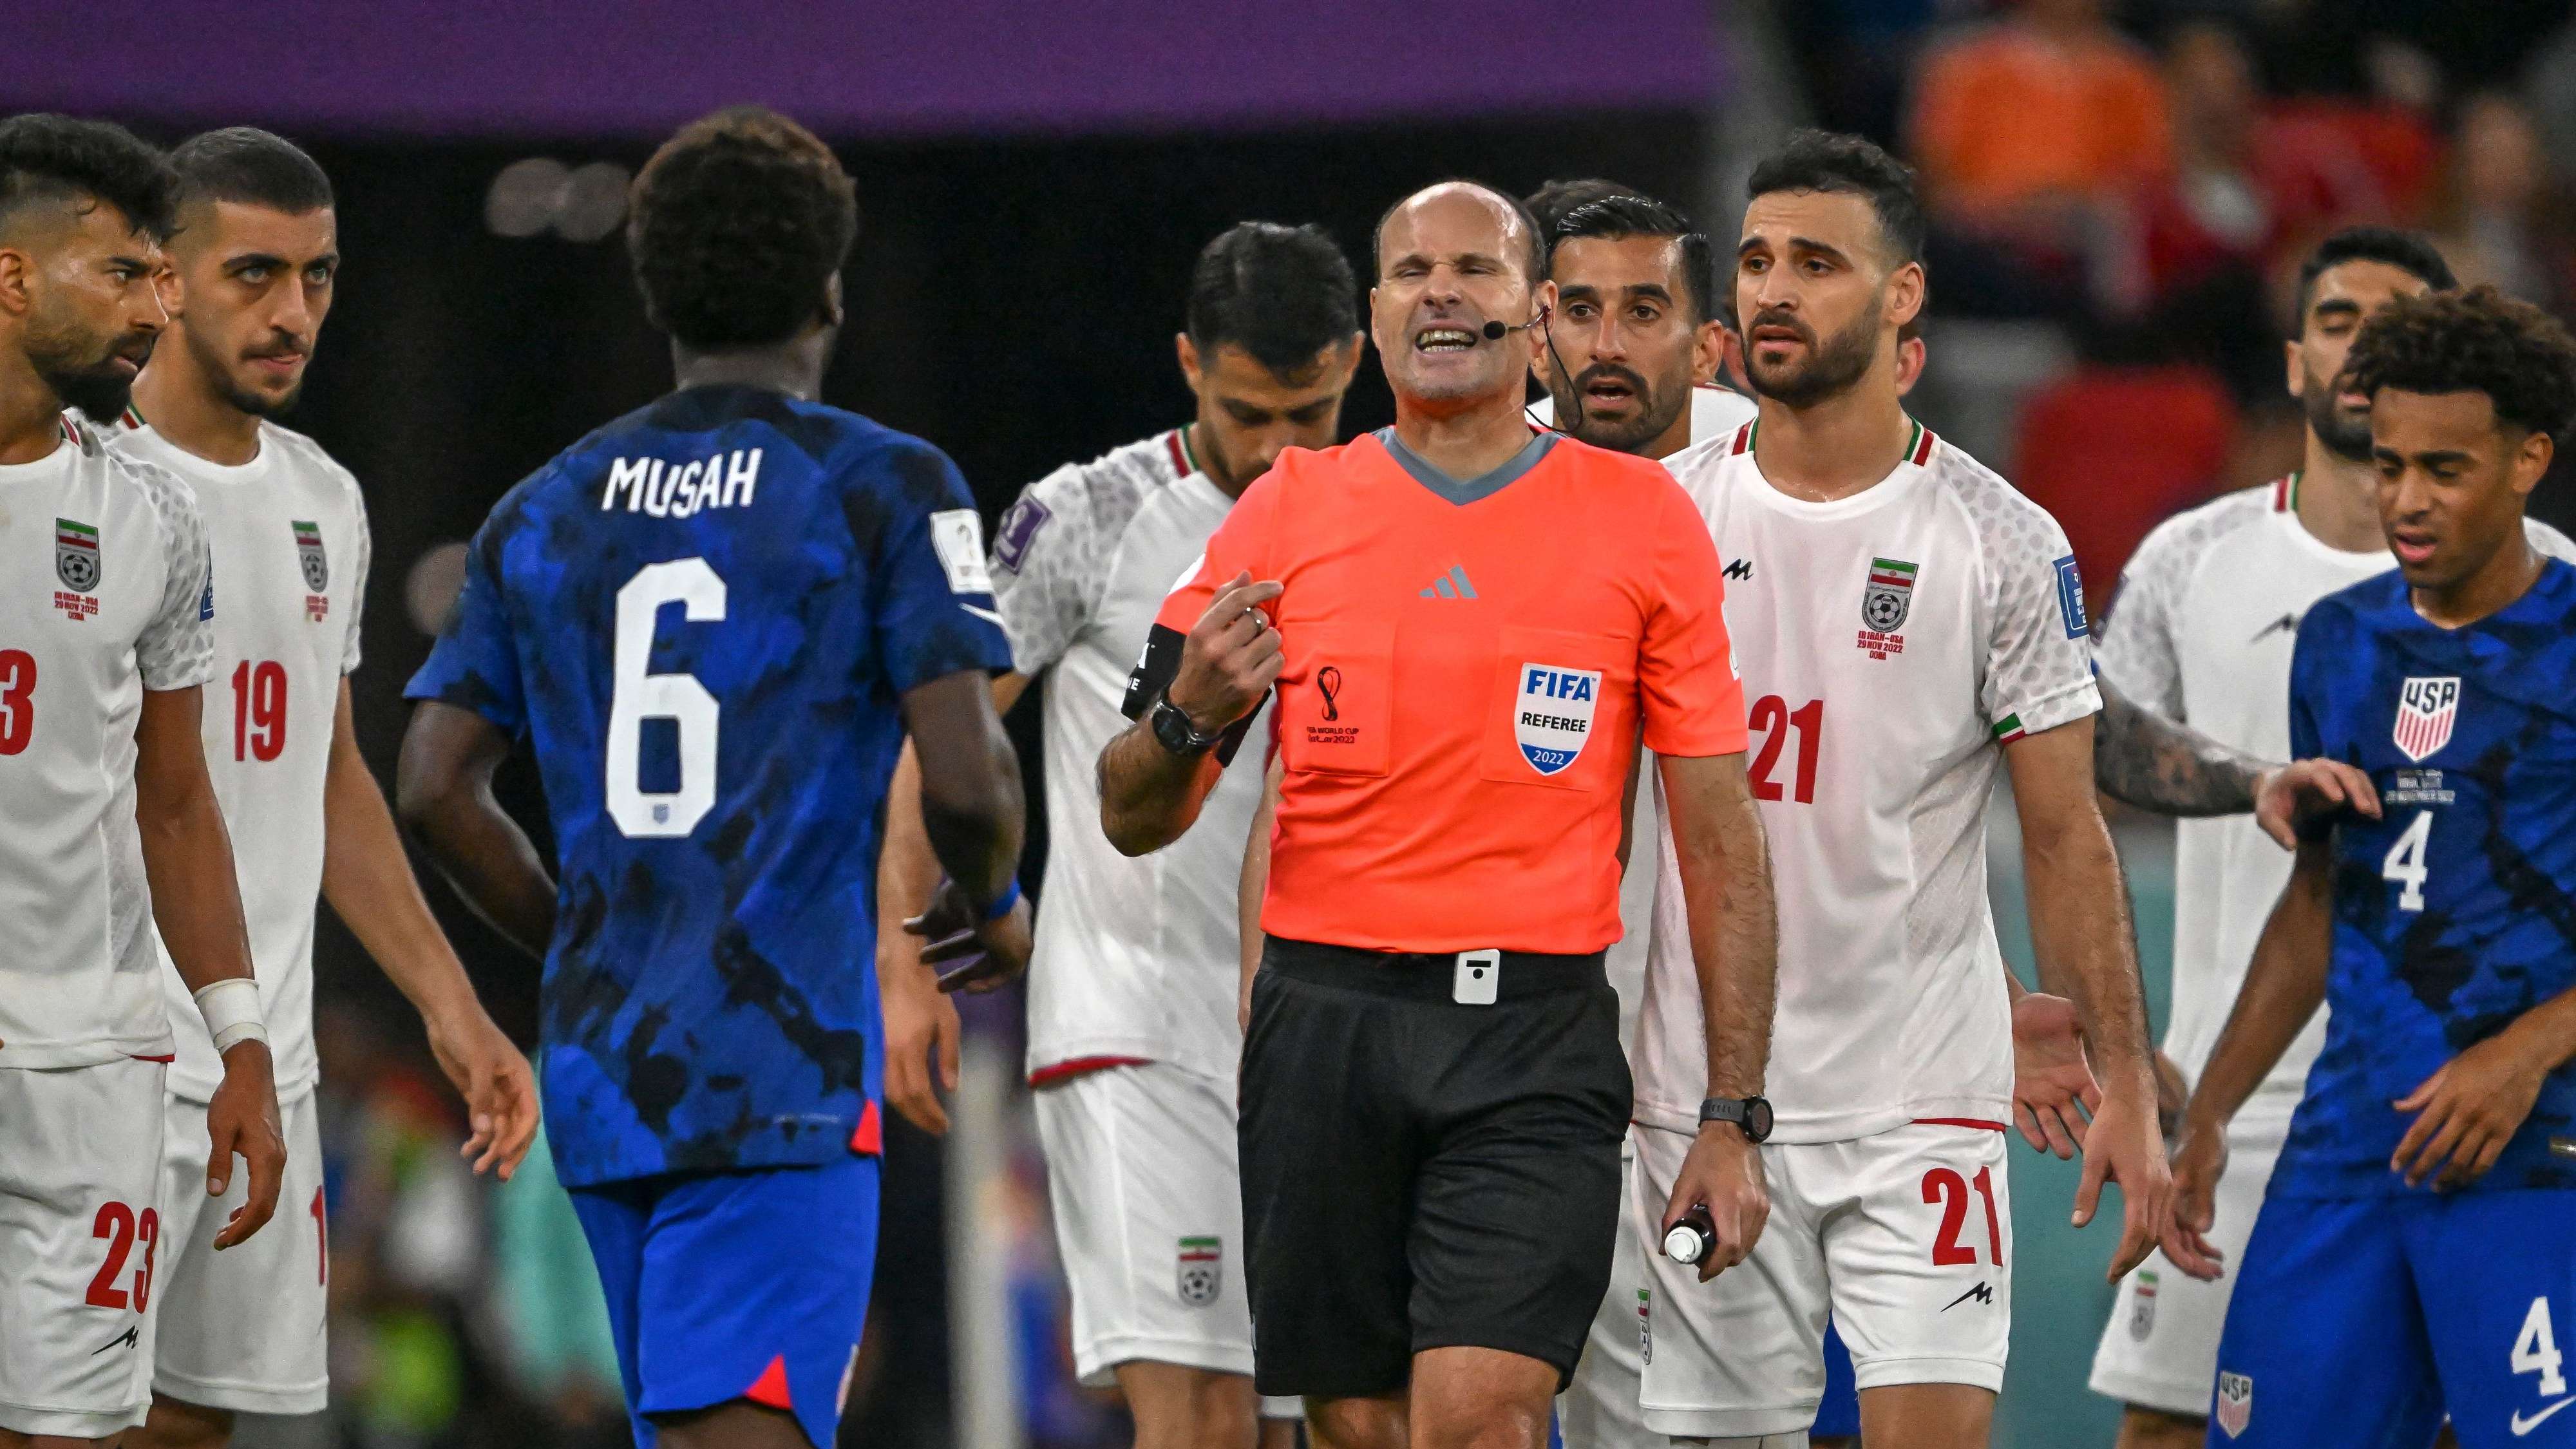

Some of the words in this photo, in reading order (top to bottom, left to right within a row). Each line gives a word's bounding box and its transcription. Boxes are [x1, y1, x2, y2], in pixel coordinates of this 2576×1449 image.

[601, 448, 762, 518] MUSAH
[1857, 639, 1866, 649] 29
[1866, 641, 1882, 650] NOV
[1883, 643, 1903, 654] 2022
[1858, 630, 1866, 639] IR
[0, 649, 37, 755] 3
[232, 661, 287, 761] 19
[606, 556, 726, 838] 6
[1521, 712, 1586, 733] REFEREE
[1526, 669, 1591, 701] FIFA
[2406, 681, 2456, 714] USA
[1533, 750, 1564, 764] 2022
[1747, 694, 1823, 804] 21
[2382, 810, 2433, 911] 4
[86, 1202, 158, 1314] 23
[1921, 1166, 2003, 1267] 21
[2221, 1375, 2249, 1401] USA
[2510, 1296, 2566, 1397] 4
